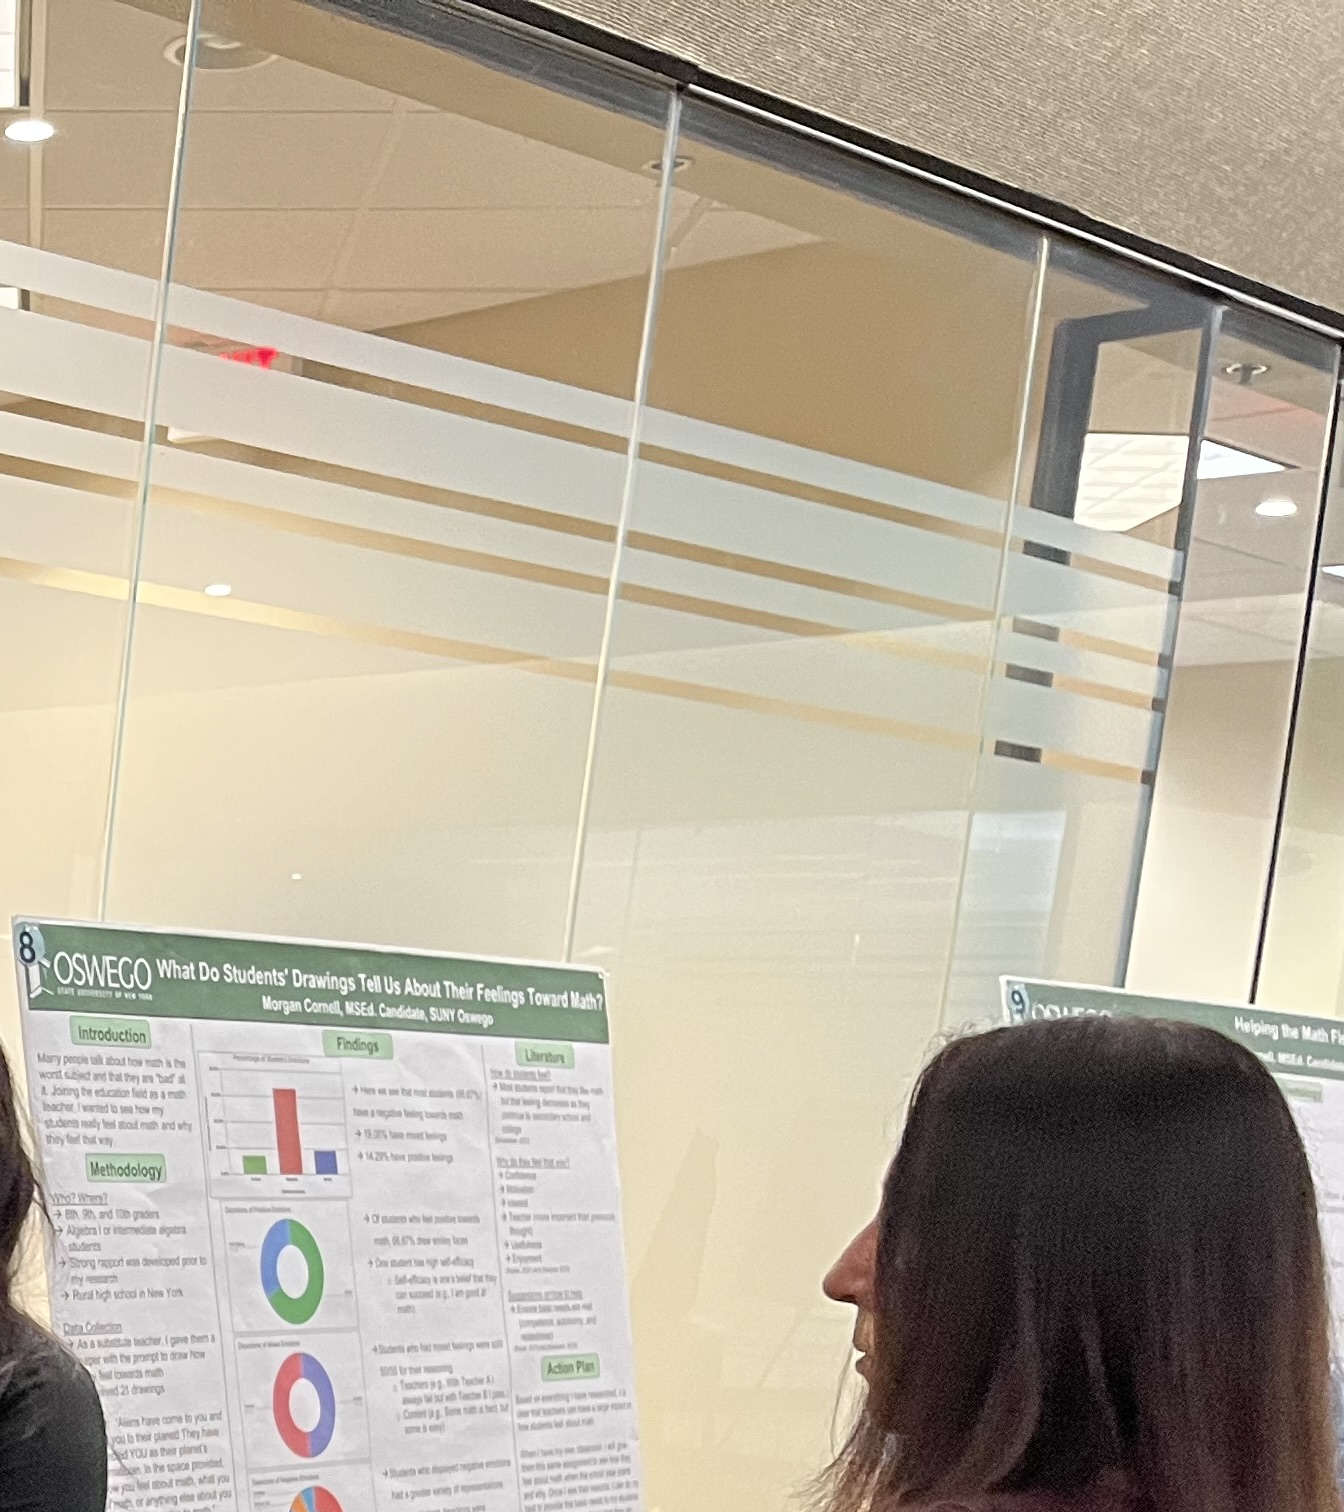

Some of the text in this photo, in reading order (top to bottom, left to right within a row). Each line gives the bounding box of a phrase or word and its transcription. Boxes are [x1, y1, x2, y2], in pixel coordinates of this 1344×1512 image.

[19, 931, 36, 964] 8
[53, 951, 152, 991] OSWEGO
[156, 958, 604, 1011] What Do Students' Drawings Tell Us About Their Feelings Toward Math?
[261, 995, 494, 1029] Morgan Cornell, MSEd. Candidate, SUNY Oswego
[1011, 989, 1026, 1015] 9
[78, 1024, 146, 1045] Introduction
[336, 1036, 379, 1056] Findings
[524, 1048, 566, 1065] Literature
[90, 1161, 163, 1182] Methodology
[547, 1360, 595, 1375] Action Plan
